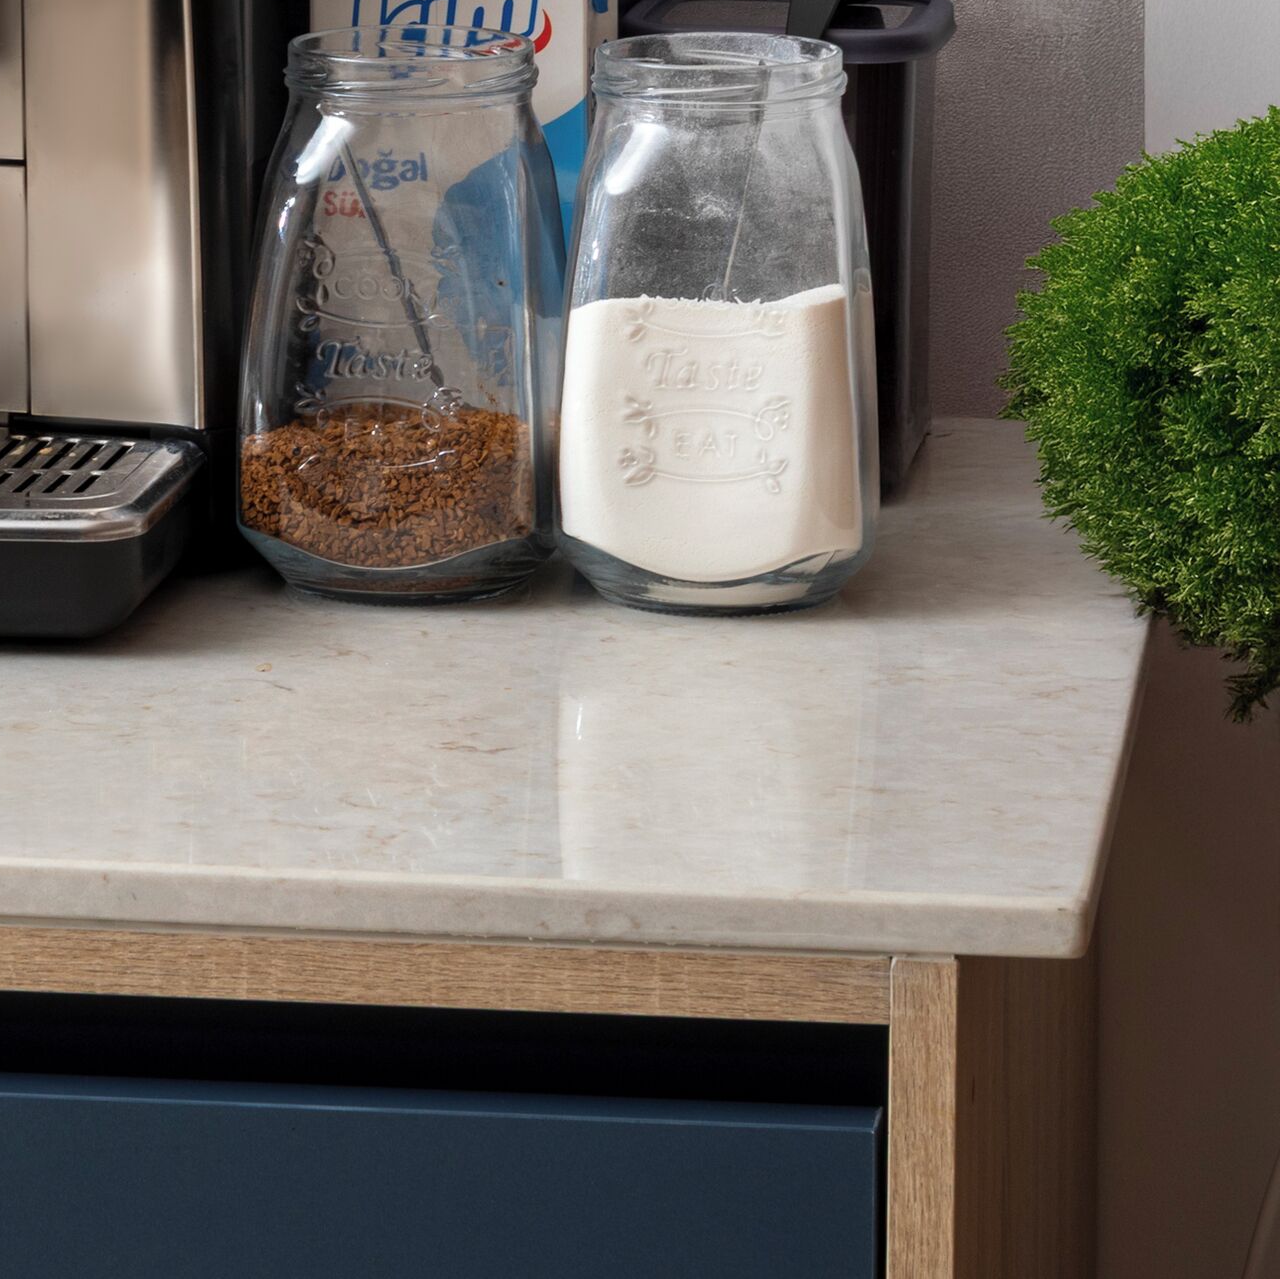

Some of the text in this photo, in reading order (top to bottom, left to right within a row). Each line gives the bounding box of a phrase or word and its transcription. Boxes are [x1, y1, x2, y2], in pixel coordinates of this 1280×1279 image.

[316, 336, 433, 382] Taste
[645, 347, 763, 391] Taste
[674, 431, 739, 459] EAT
